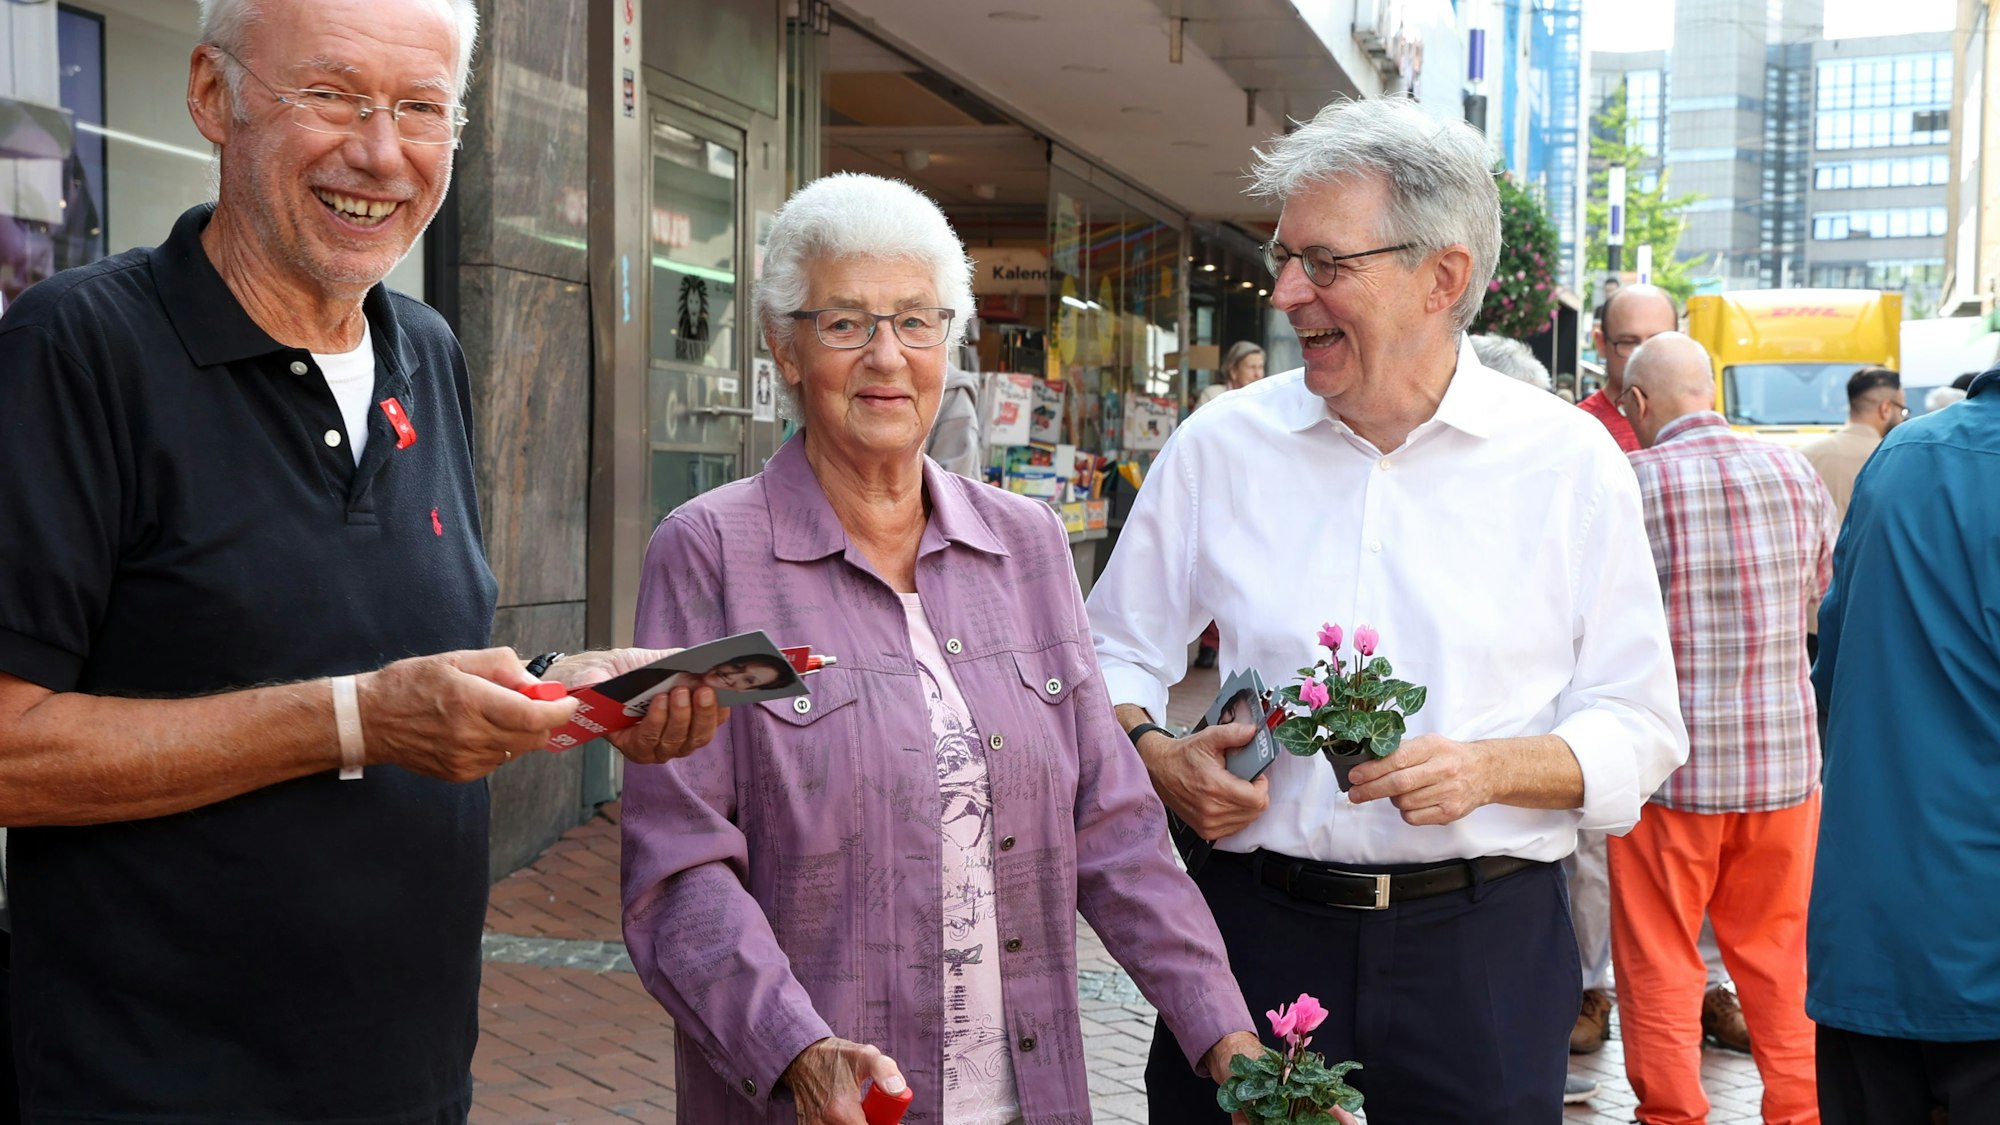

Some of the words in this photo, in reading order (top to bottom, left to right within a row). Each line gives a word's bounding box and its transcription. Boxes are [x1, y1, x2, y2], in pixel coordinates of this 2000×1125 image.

[992, 264, 1067, 280] Kalende
[1772, 306, 1839, 318] DHL
[551, 734, 577, 745] SPD
[1257, 730, 1269, 758] SPD
